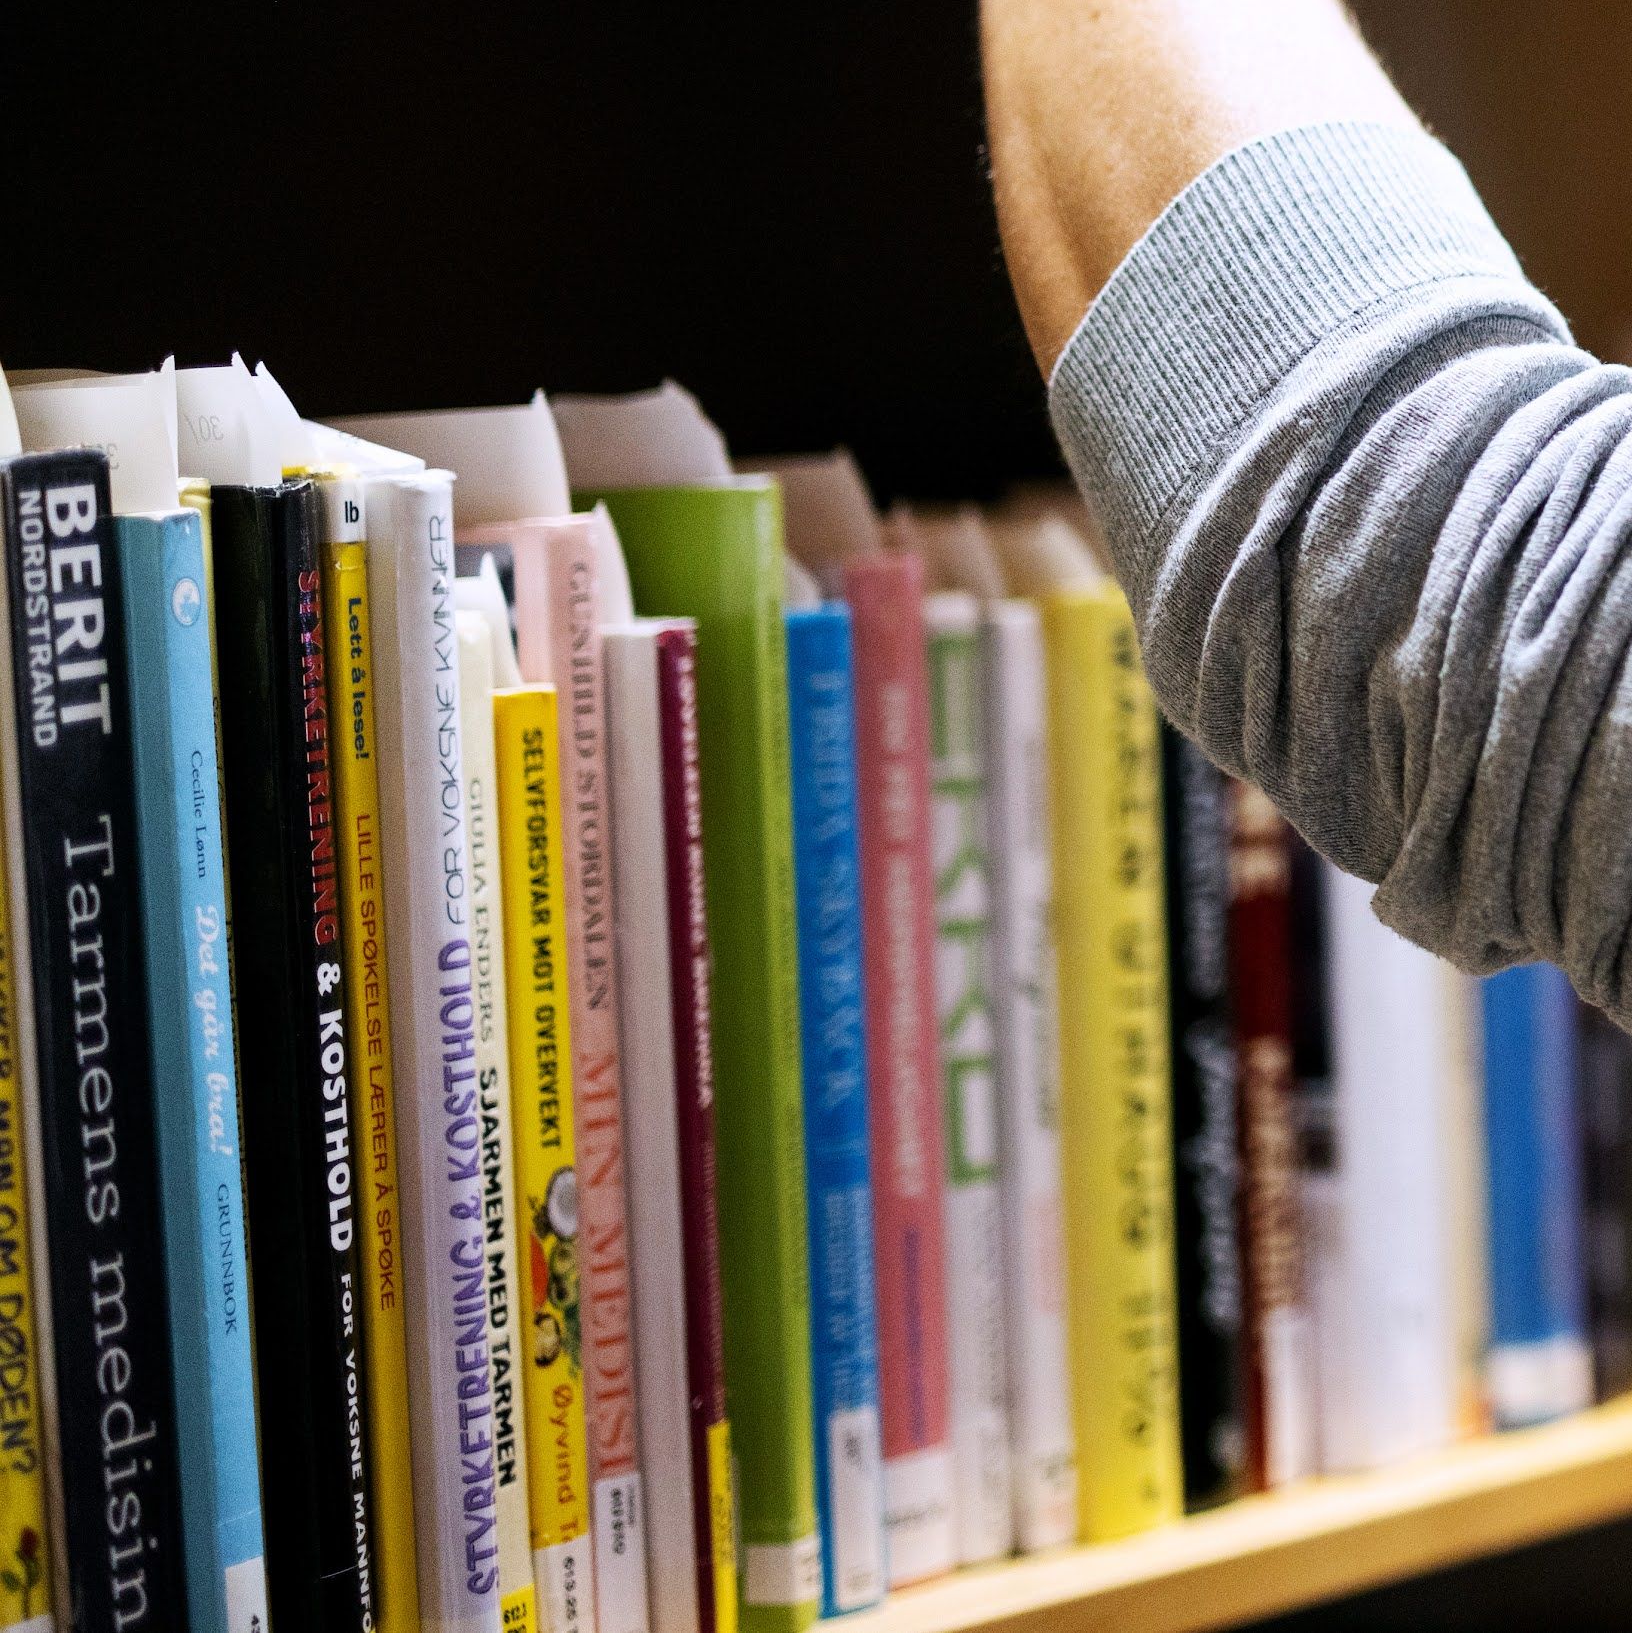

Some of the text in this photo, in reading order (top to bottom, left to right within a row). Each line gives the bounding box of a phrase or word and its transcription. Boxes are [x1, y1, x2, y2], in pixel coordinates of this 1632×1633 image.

[18, 489, 58, 747] NORDSTRAND
[46, 483, 112, 735] BERIT
[348, 597, 369, 759] Lett å lese!
[191, 750, 207, 879] Cecilie Lønn
[299, 569, 339, 947] STYRKETRENING
[437, 683, 460, 837] VOKSNE
[195, 904, 219, 980] Det
[444, 847, 466, 926] FOR
[468, 777, 494, 1044] GIULIA ENDERS
[522, 727, 562, 1149] SELVFORSVAR MOT OVERVEKT
[577, 767, 607, 1011] STORDALEN
[194, 989, 224, 1059] går
[317, 963, 340, 996] &
[206, 1072, 233, 1156] bra!
[319, 1008, 353, 1252] KOSTHOLD
[357, 814, 395, 1311] LILLE SPØKELSE LÆRER Å SPØKE
[438, 940, 481, 1182] KOSTHOLD
[580, 1052, 618, 1189] MIN
[63, 813, 158, 1633] Tarmens medisin
[217, 1183, 238, 1335] GRUNNBOK
[479, 1068, 516, 1488] SJARMEN MED TARMEN
[341, 1272, 354, 1338] FOR
[345, 1349, 364, 1479] VOKSNE
[450, 1235, 499, 1596] STYRKETRENING
[549, 1381, 576, 1504] Øyvind
